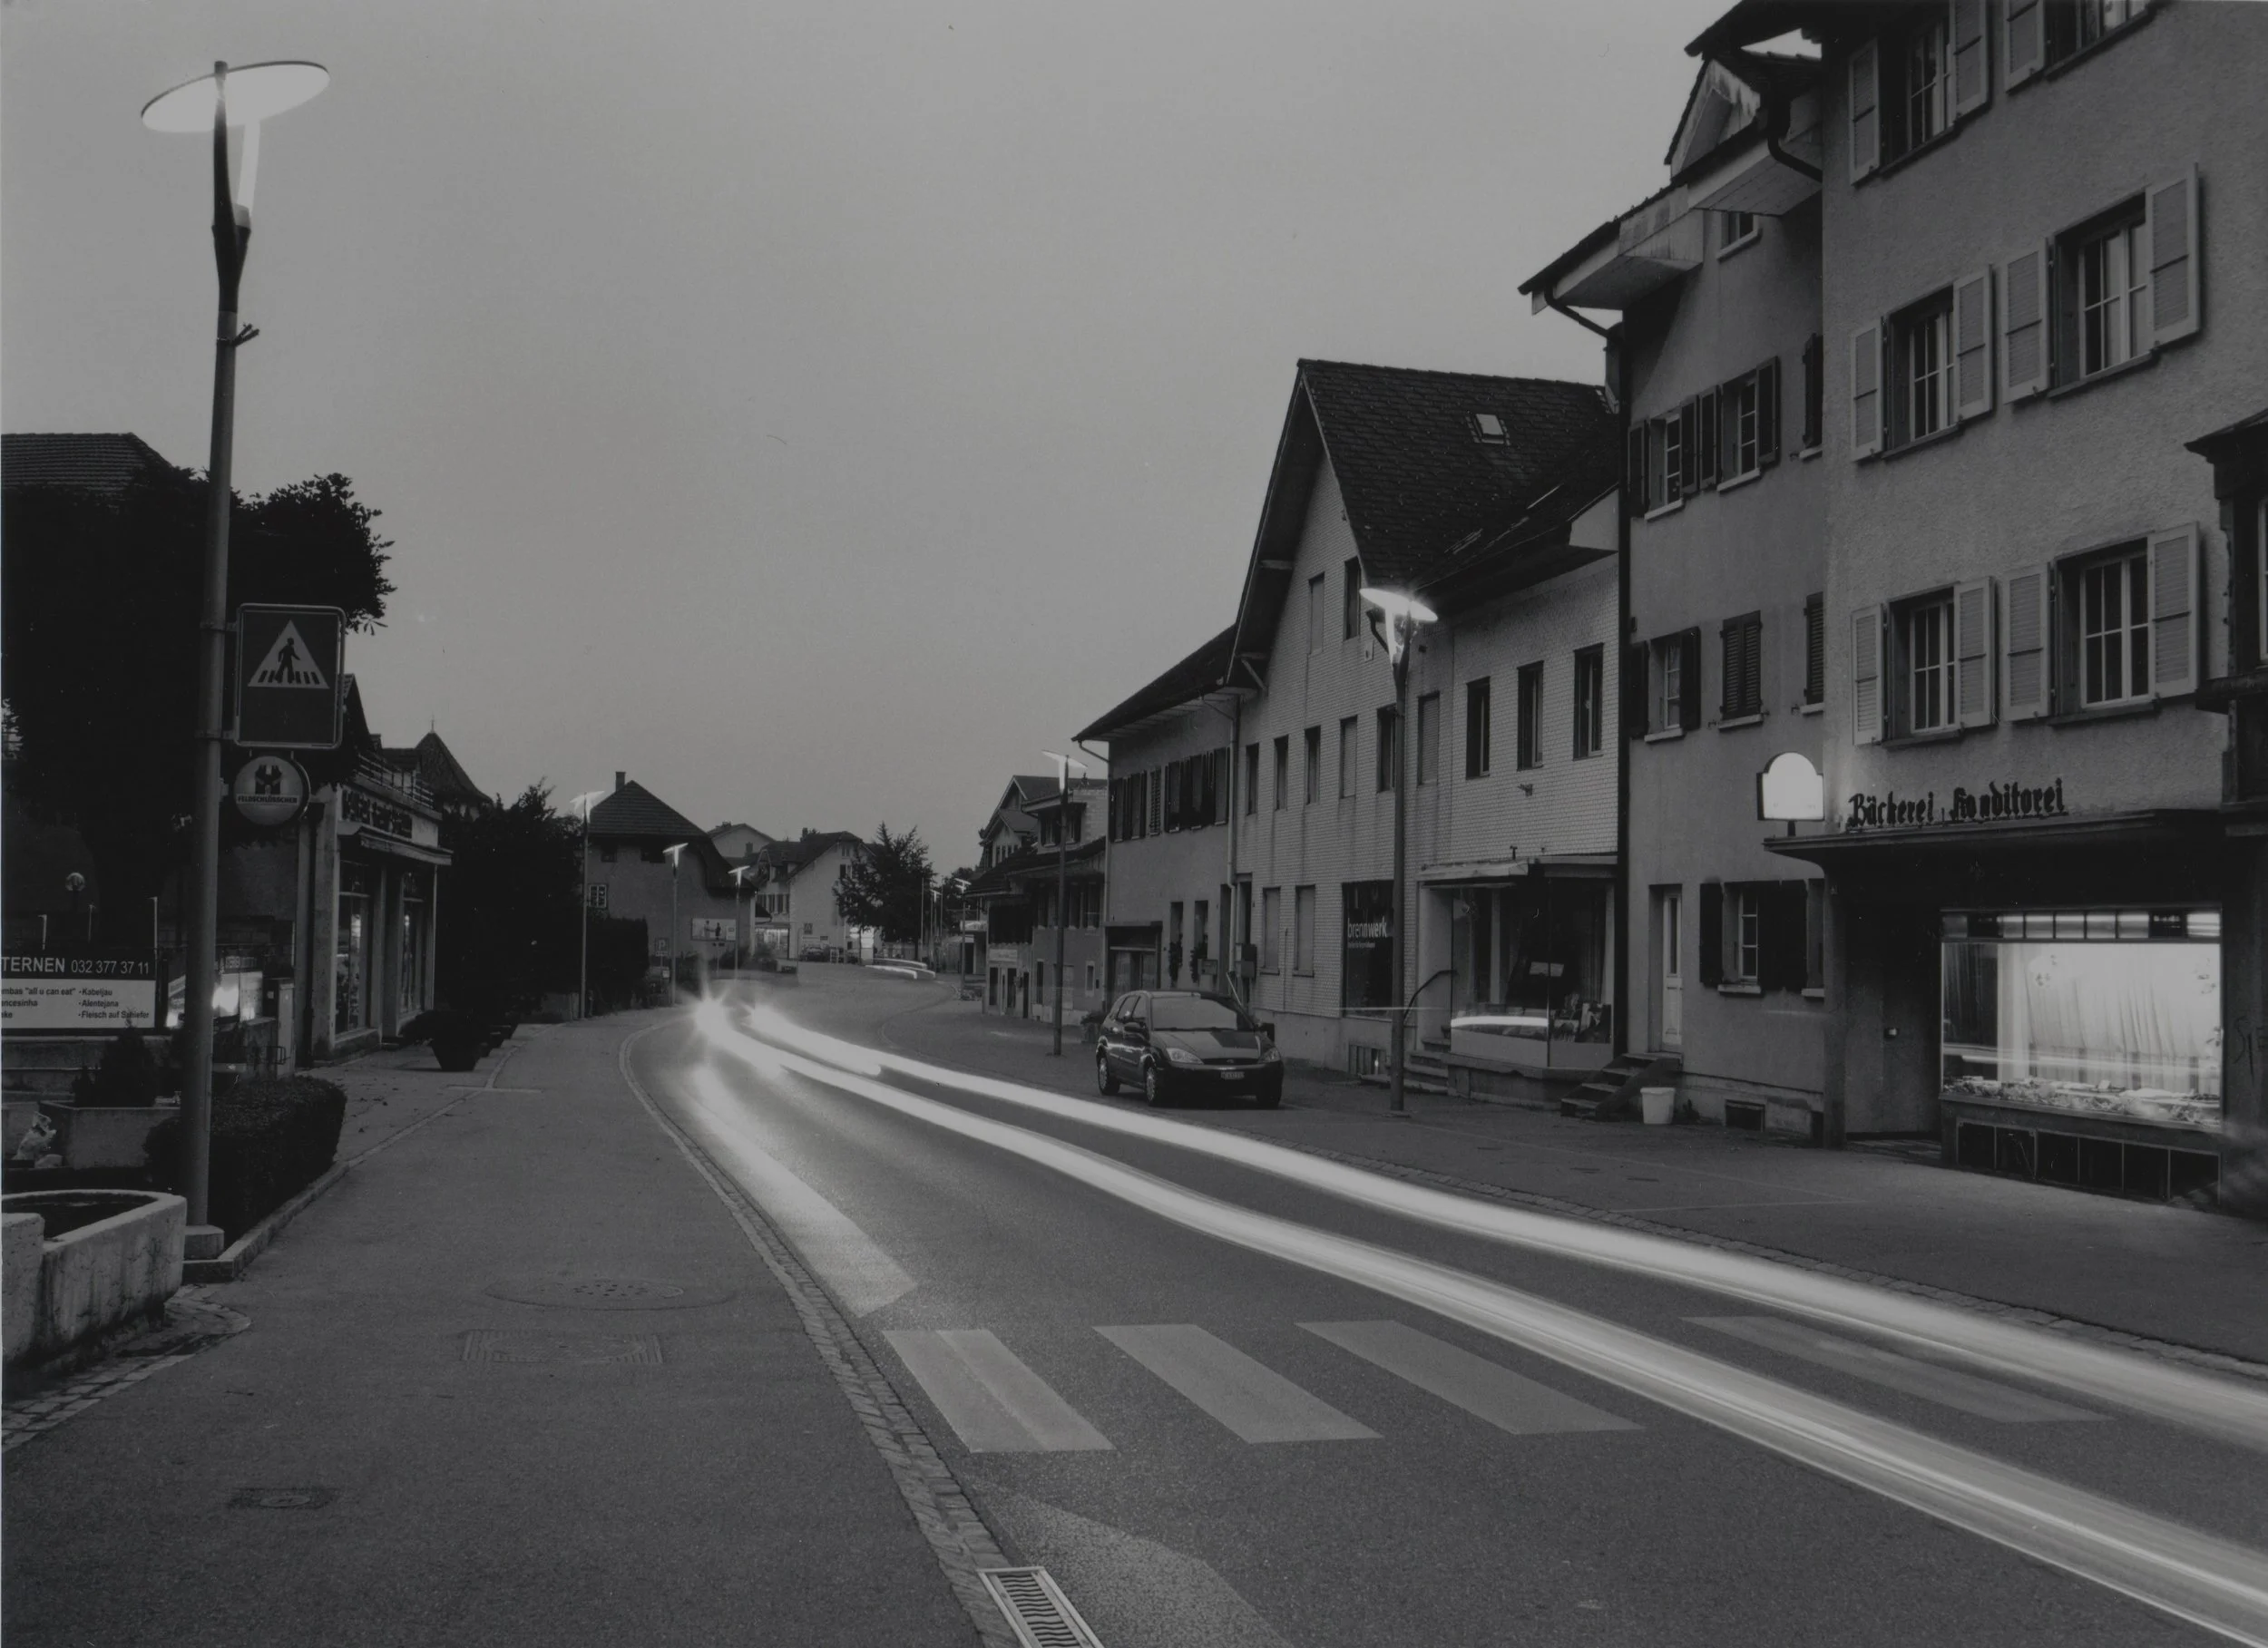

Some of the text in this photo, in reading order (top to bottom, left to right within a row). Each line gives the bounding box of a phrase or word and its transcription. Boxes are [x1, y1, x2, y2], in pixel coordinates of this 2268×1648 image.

[1847, 778, 2065, 827] Bäckerei Konditorei
[71, 960, 93, 973] 032
[95, 961, 117, 974] 377
[120, 961, 135, 974] 37
[138, 961, 150, 975] 11
